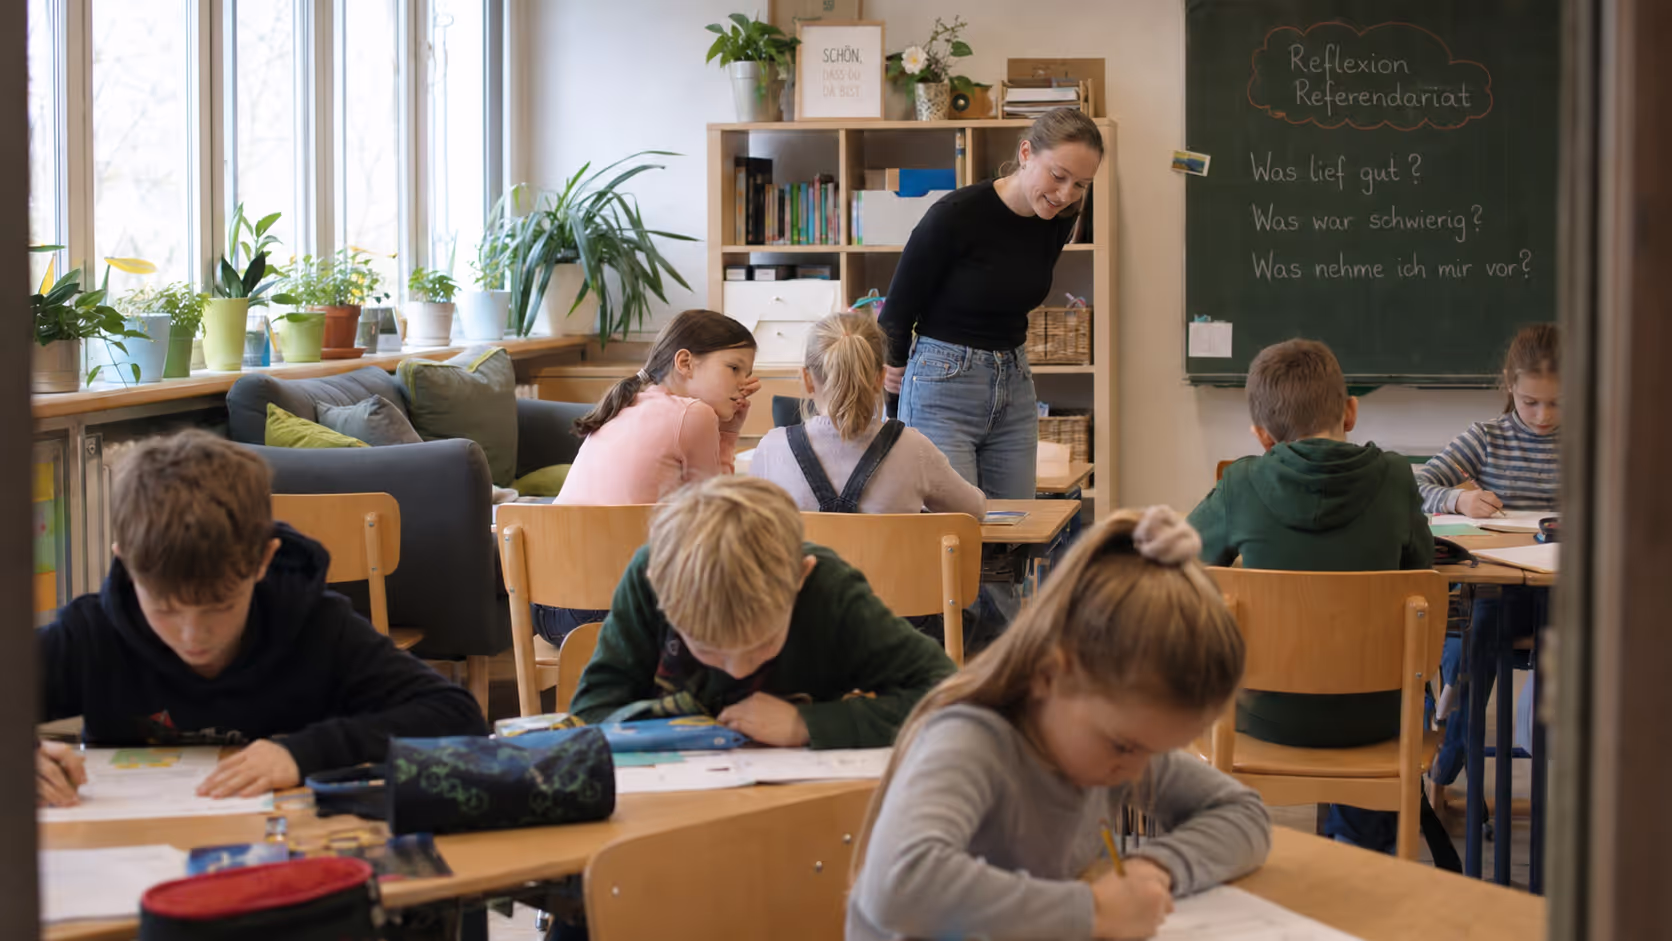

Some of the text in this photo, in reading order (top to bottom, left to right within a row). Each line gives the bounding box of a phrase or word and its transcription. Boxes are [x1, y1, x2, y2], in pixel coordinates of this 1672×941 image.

[822, 45, 863, 65] SCHÖN,
[1290, 43, 1409, 82] Reflexion
[1295, 79, 1472, 117] Referendariat
[1250, 151, 1297, 182] Was
[1310, 154, 1346, 191] lief
[1252, 202, 1483, 243] Was war schwierig?
[1252, 248, 1532, 281] Was nehme ich mir vor?
